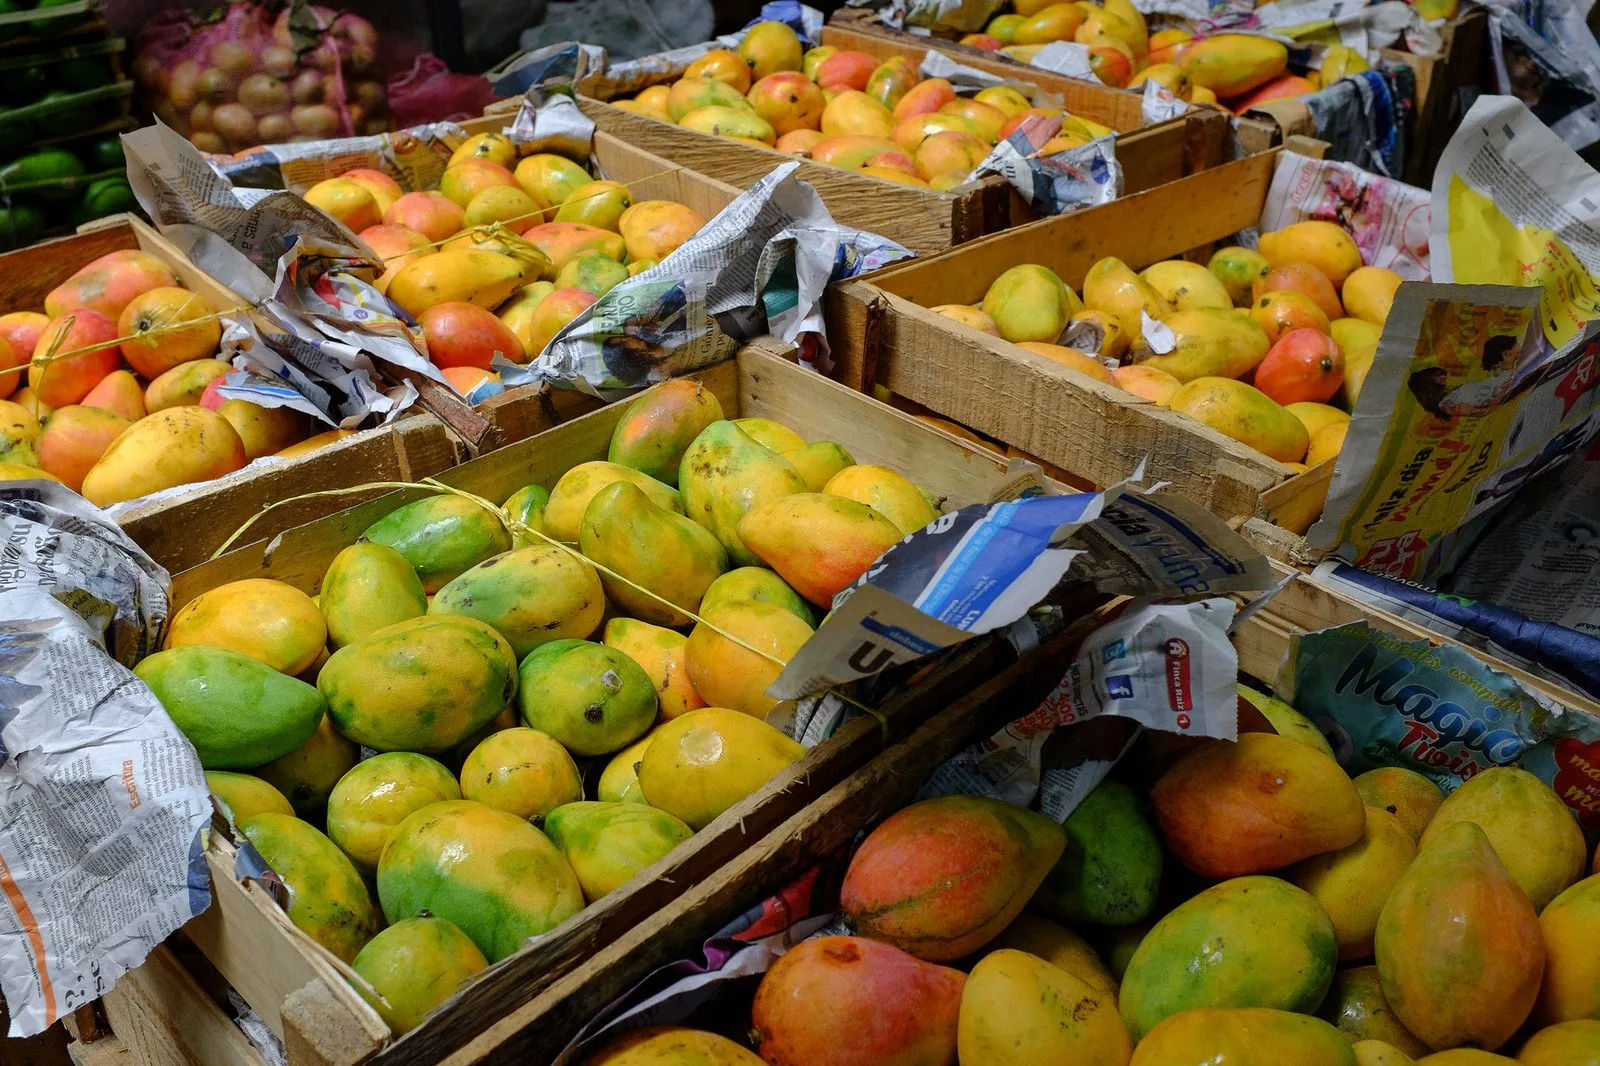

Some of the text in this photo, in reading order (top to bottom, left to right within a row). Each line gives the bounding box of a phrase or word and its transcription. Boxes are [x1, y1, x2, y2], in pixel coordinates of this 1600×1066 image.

[1098, 504, 1151, 539] cia
[1172, 660, 1182, 688] Finca
[1335, 643, 1523, 764] Magic
[121, 759, 141, 809] Escritura
